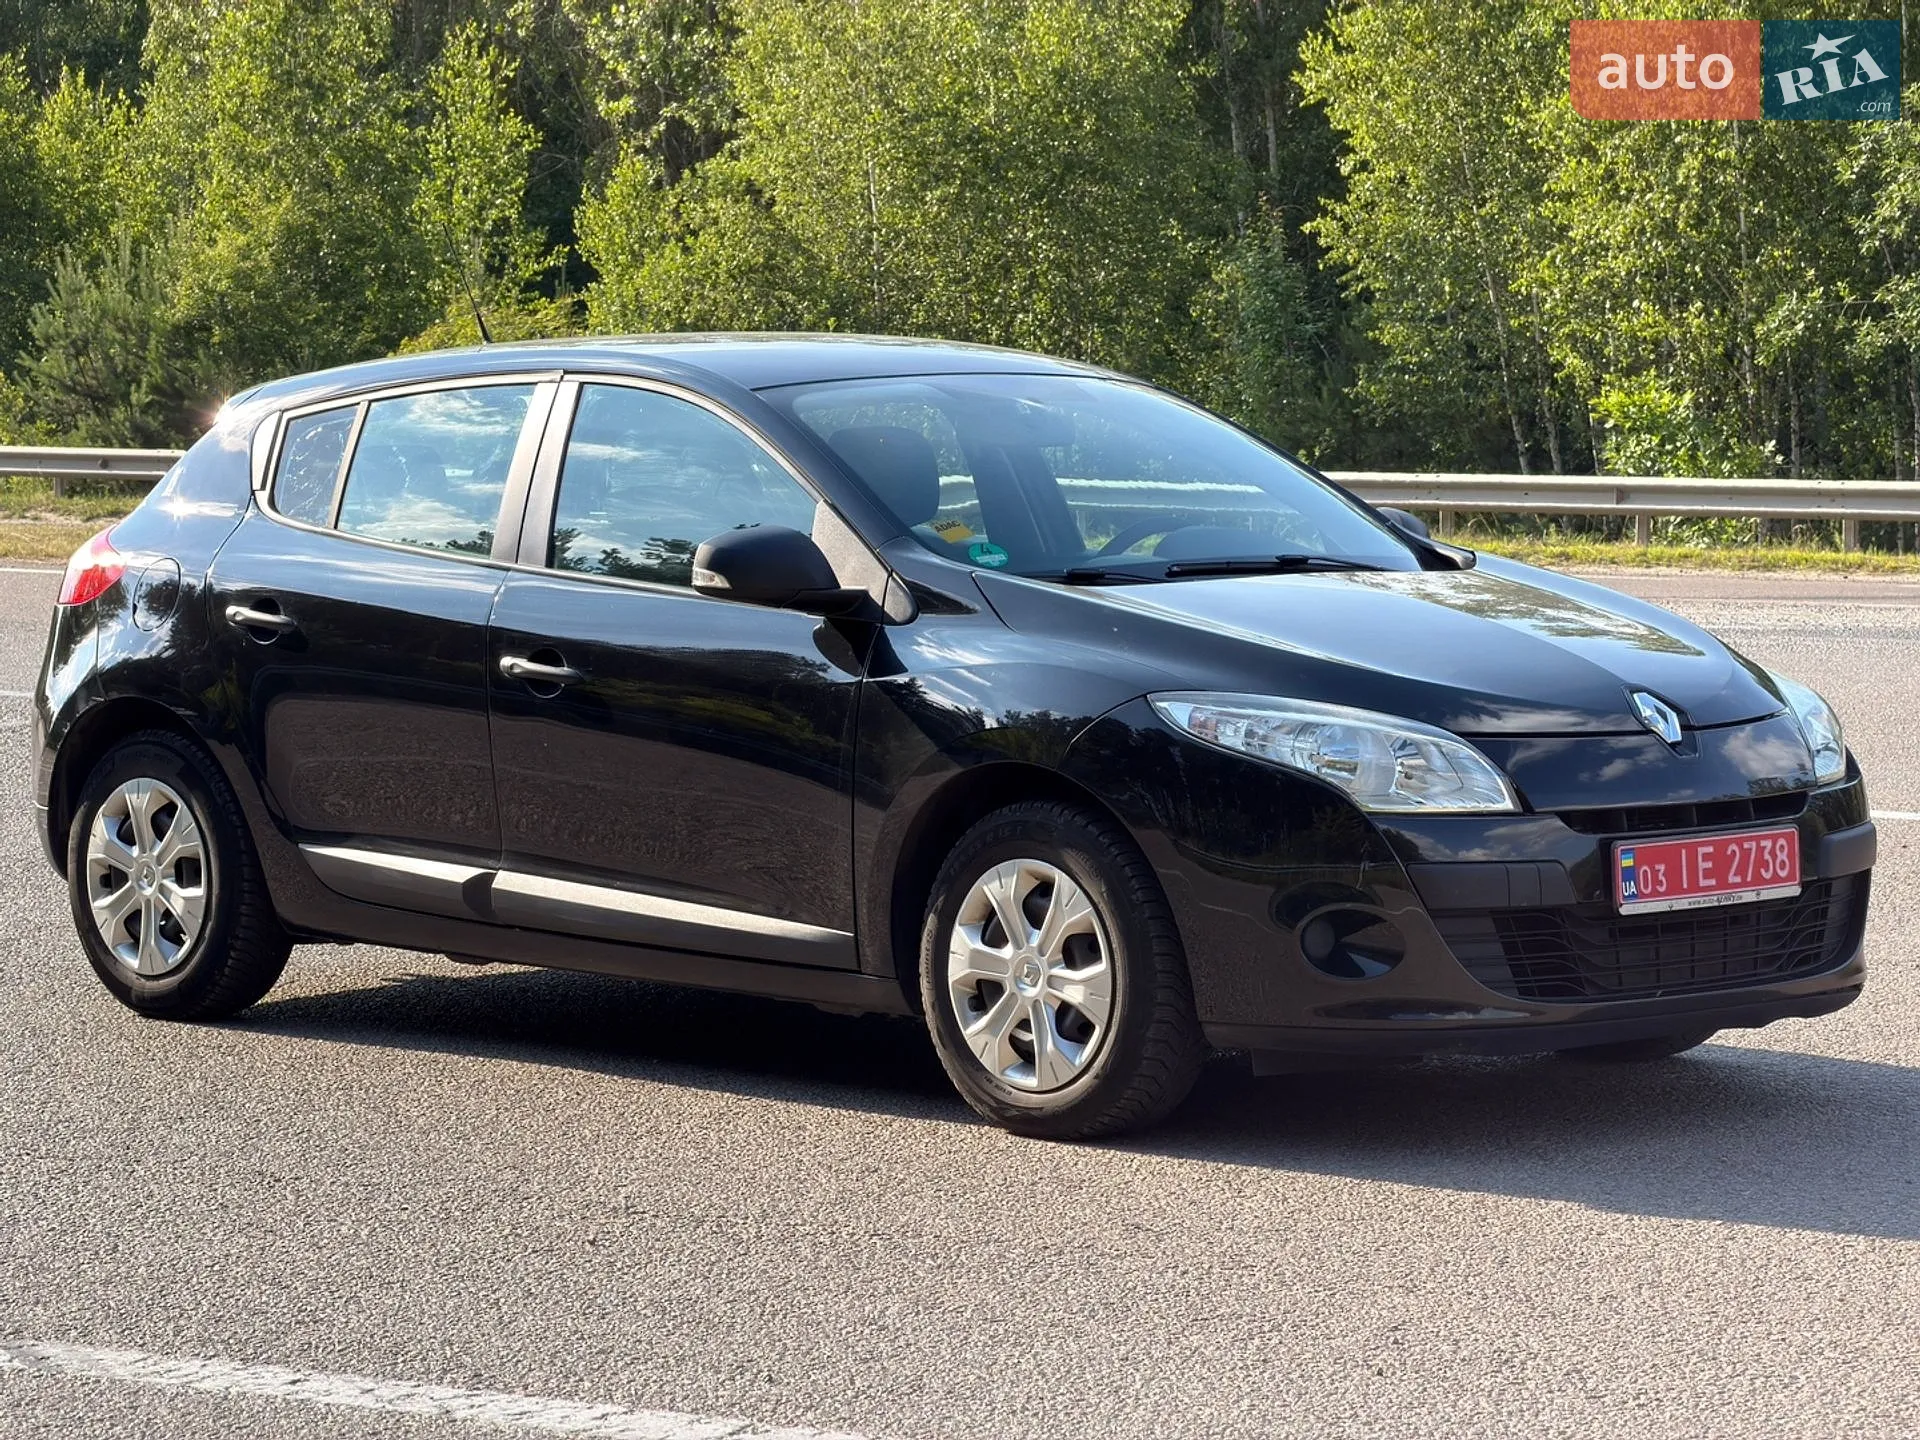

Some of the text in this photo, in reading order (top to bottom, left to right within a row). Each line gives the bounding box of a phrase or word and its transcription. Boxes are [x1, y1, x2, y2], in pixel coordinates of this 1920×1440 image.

[934, 520, 961, 533] ADAC
[1622, 837, 1790, 896] UA 03 IE 2738
